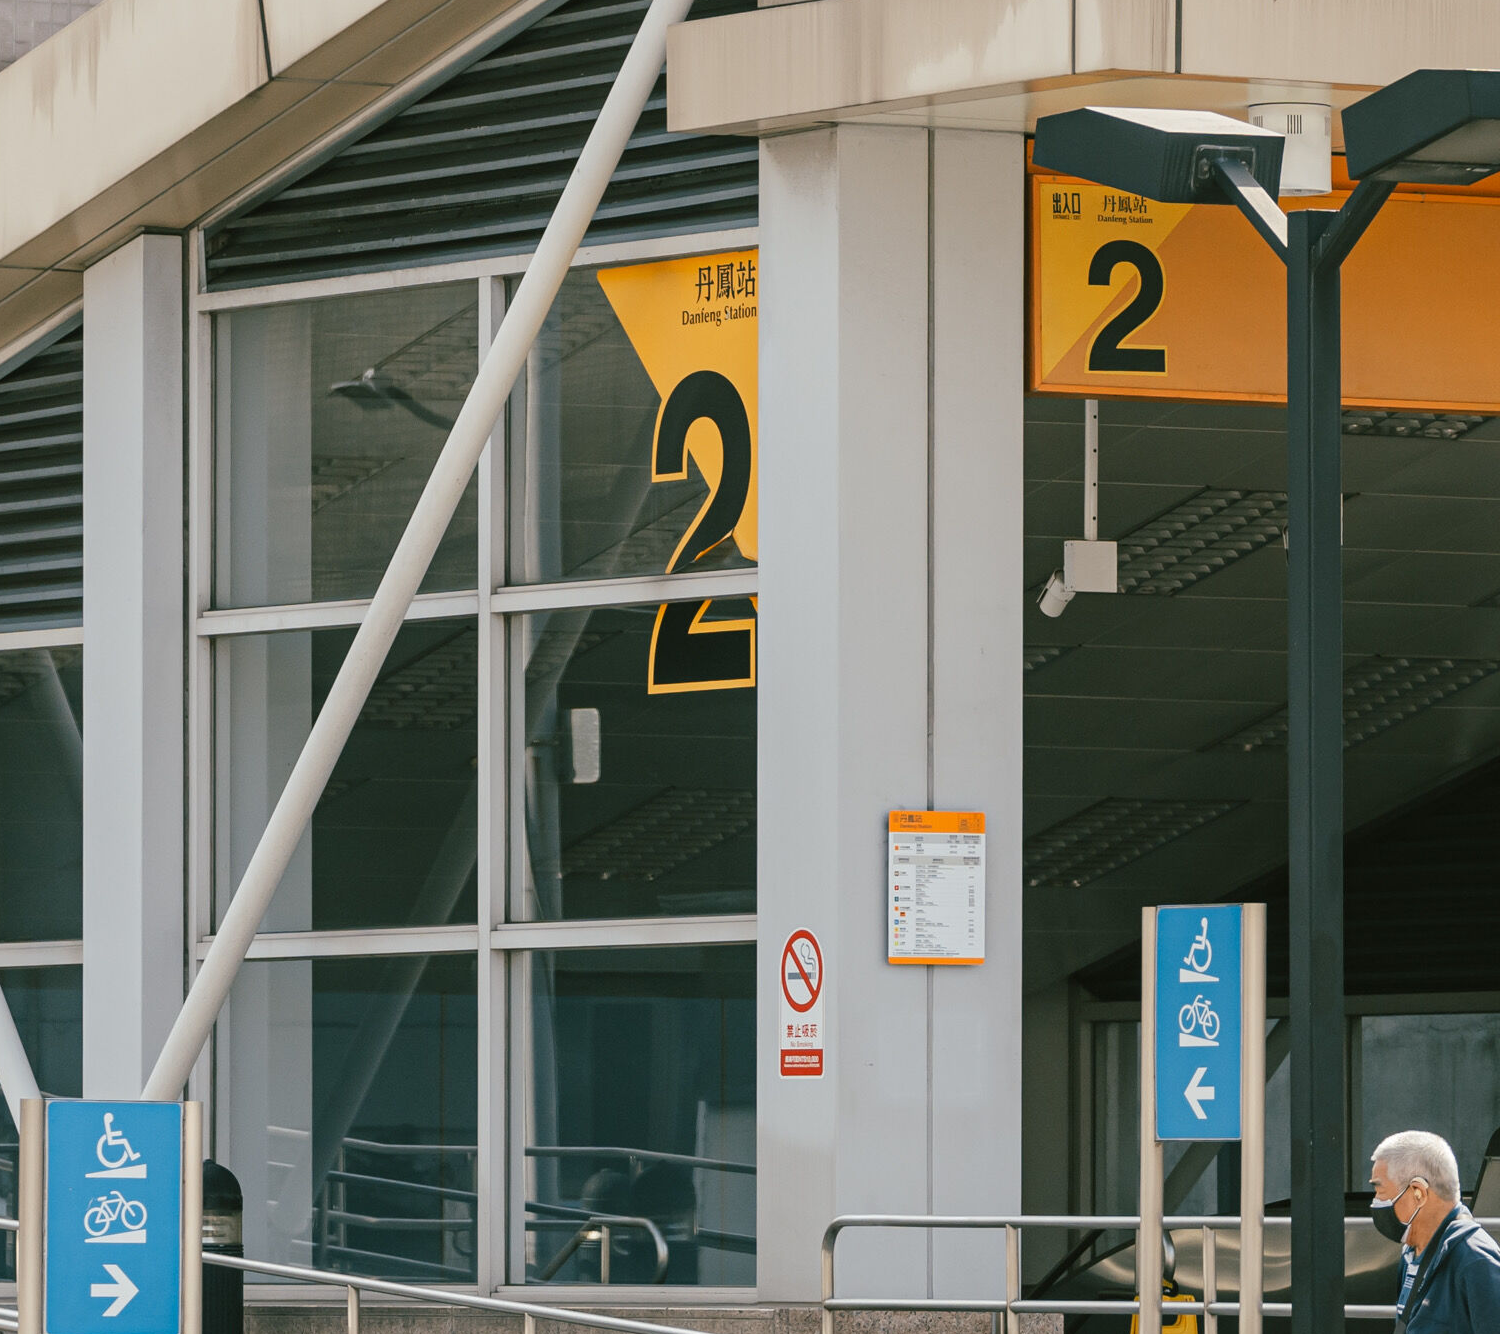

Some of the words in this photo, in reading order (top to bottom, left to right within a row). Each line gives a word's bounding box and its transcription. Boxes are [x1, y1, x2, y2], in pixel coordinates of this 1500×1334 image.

[1053, 193, 1081, 214] 出入口
[1103, 194, 1148, 214] 丹鳳站
[1098, 214, 1127, 225] Danfeng
[1129, 216, 1154, 224] Station
[694, 260, 758, 303] 丹鳳站
[681, 307, 722, 327] Danfeng
[724, 304, 758, 323] Station
[1087, 239, 1167, 373] 2
[650, 369, 757, 691] 2
[786, 1023, 818, 1038] 禁止吸菸
